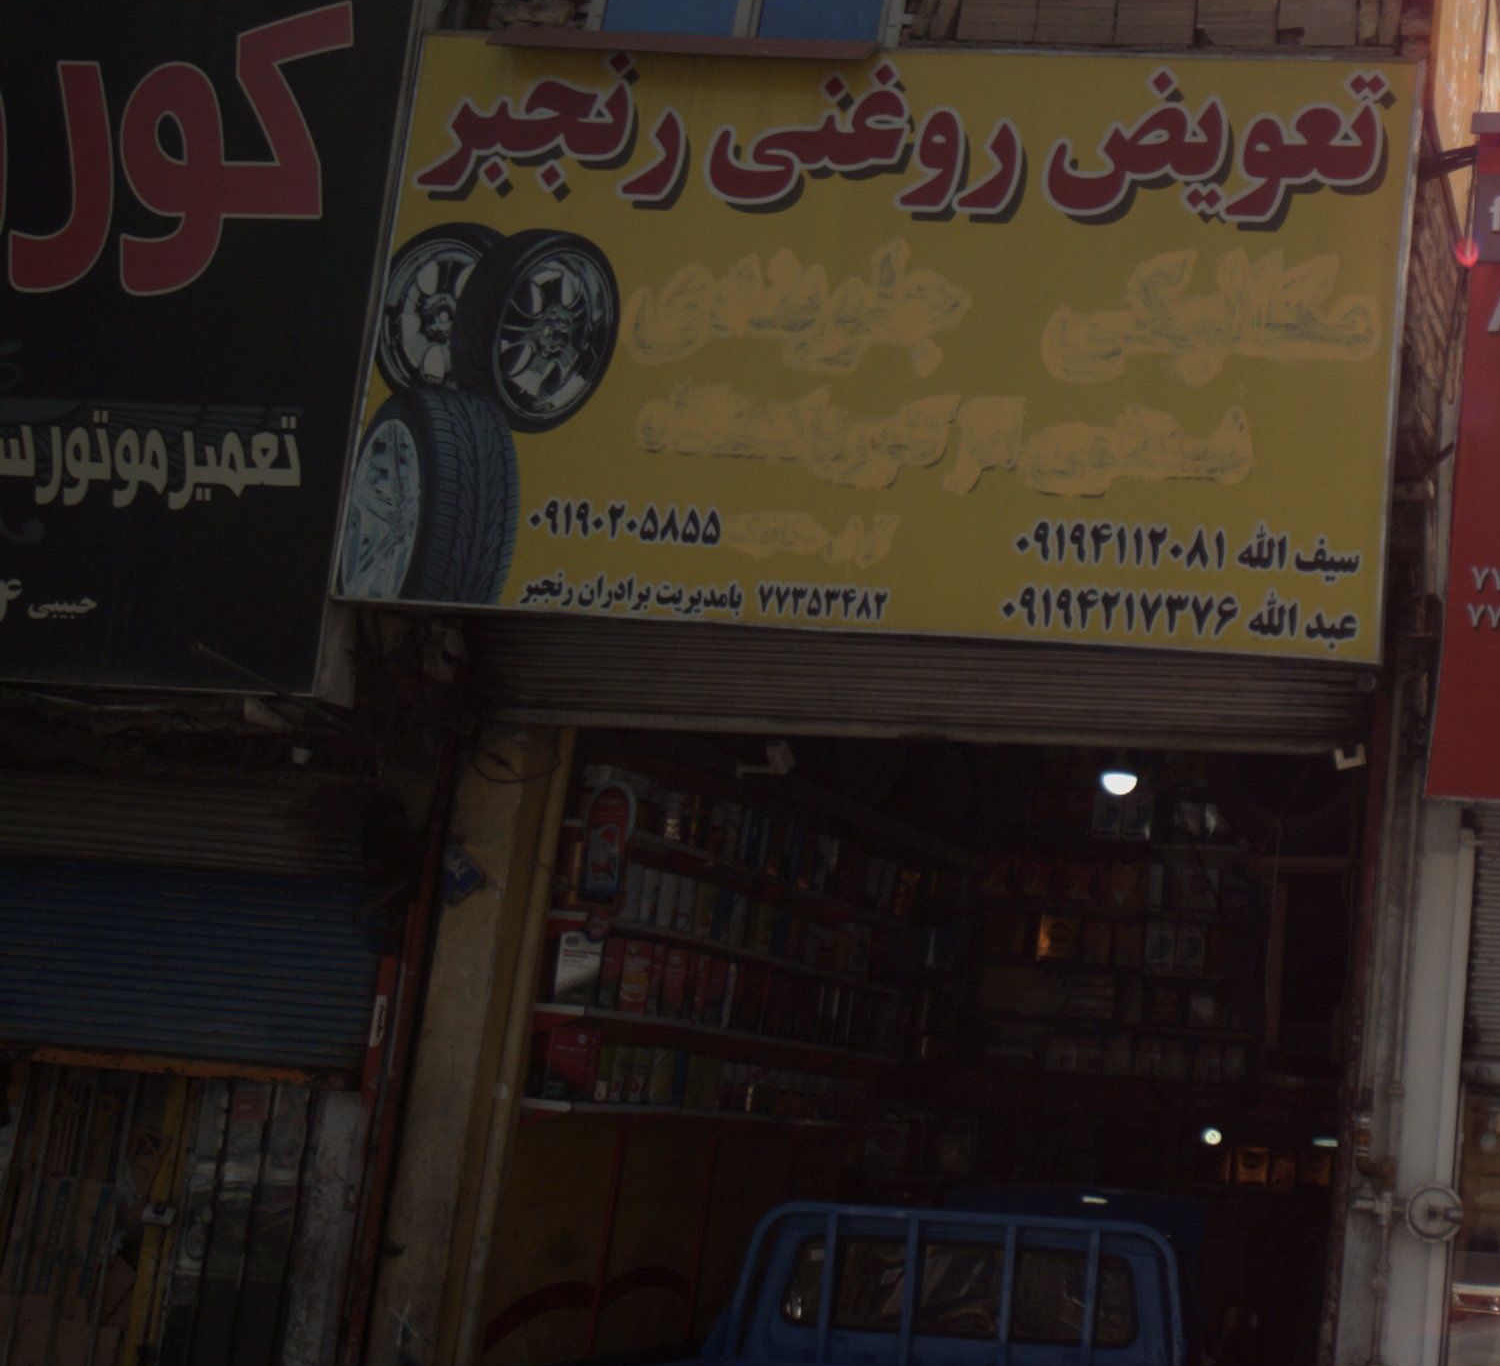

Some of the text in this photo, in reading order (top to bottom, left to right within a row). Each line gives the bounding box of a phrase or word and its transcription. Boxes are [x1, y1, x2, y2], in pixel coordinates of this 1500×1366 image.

[0, 0, 354, 296] کور
[412, 49, 1388, 223] تعویض روغنی رنجبر
[168, 413, 301, 511] تعمیر
[528, 498, 724, 546] ۰۹۱۹۰۲۰۵۸۵۵
[1016, 520, 1361, 582] سیف الله ۰۹۱۹۴۱۱۲۰۸۱
[519, 571, 575, 608] رنجبر
[577, 574, 651, 612] برادران
[757, 582, 889, 621] ۷۷۳۵۳۴۸۲
[1000, 586, 1359, 650] عبد الله ۰۹۱۹۴۲۱۷۳۷۶
